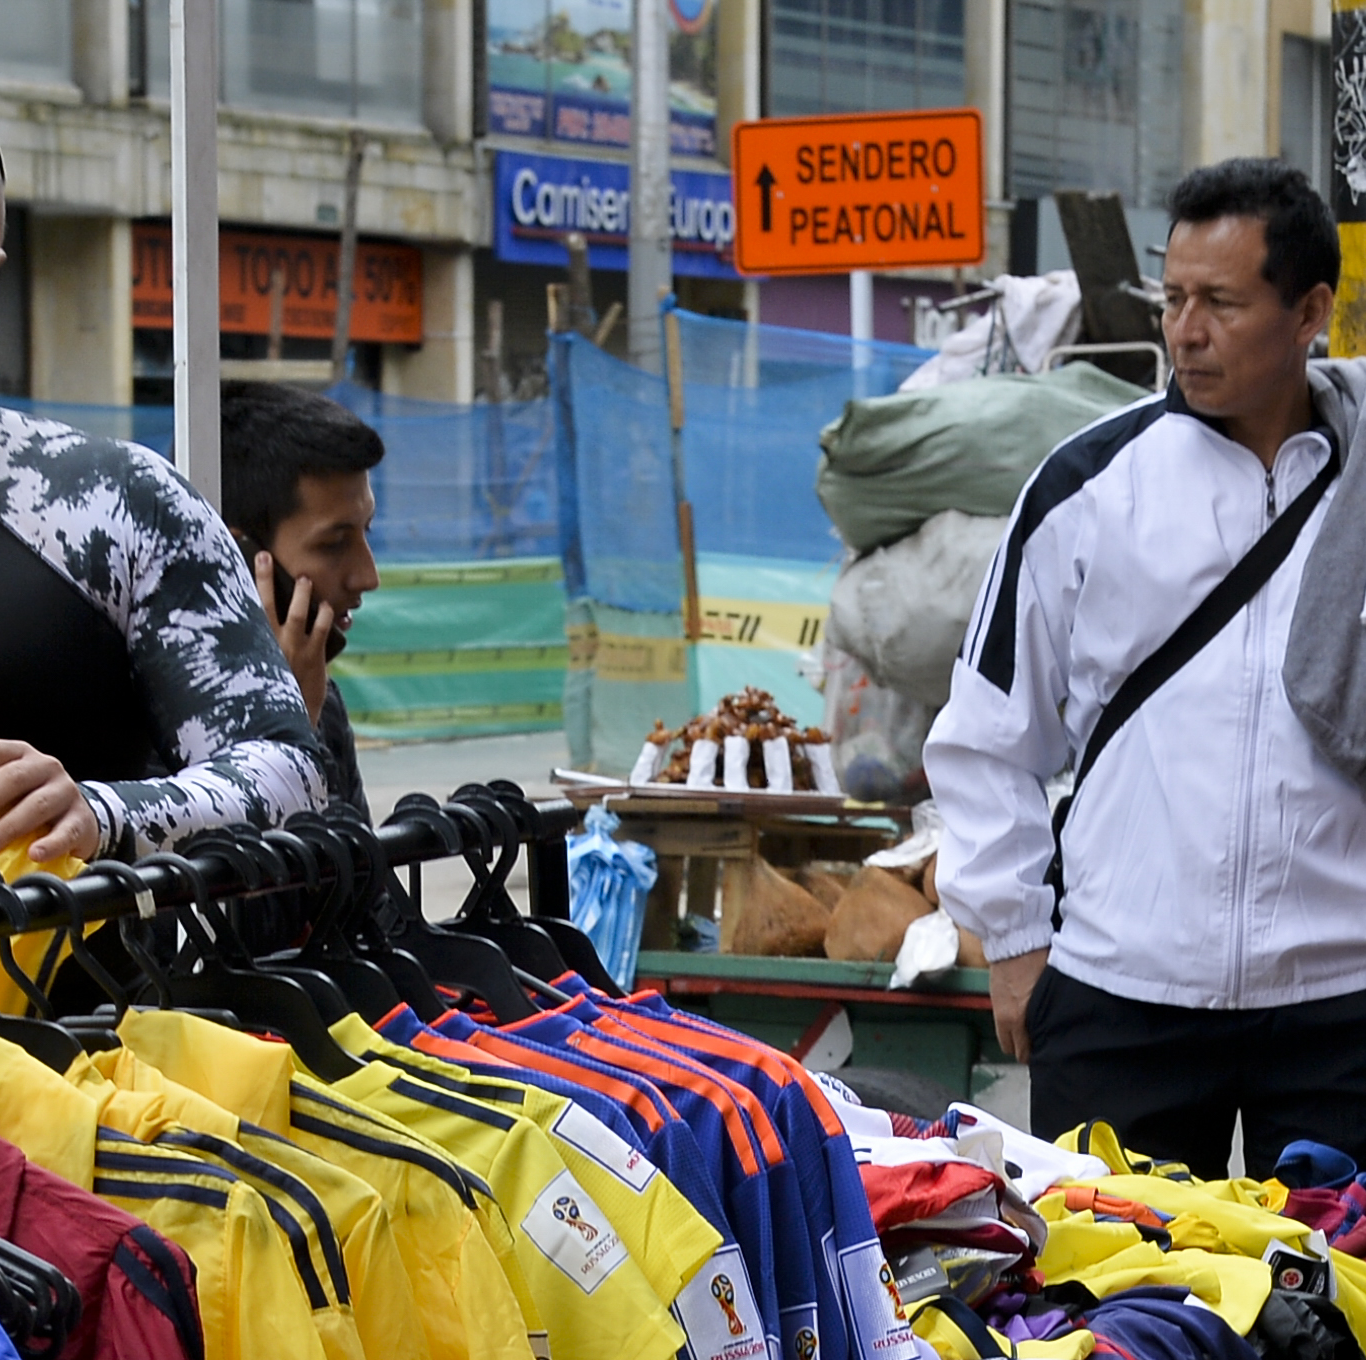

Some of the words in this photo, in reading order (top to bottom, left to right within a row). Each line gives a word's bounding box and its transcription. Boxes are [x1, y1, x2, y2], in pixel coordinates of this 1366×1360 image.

[796, 138, 957, 184] SENDERO
[512, 168, 631, 231] Camiser
[790, 201, 967, 246] PEATONAL
[237, 246, 315, 299] TODO
